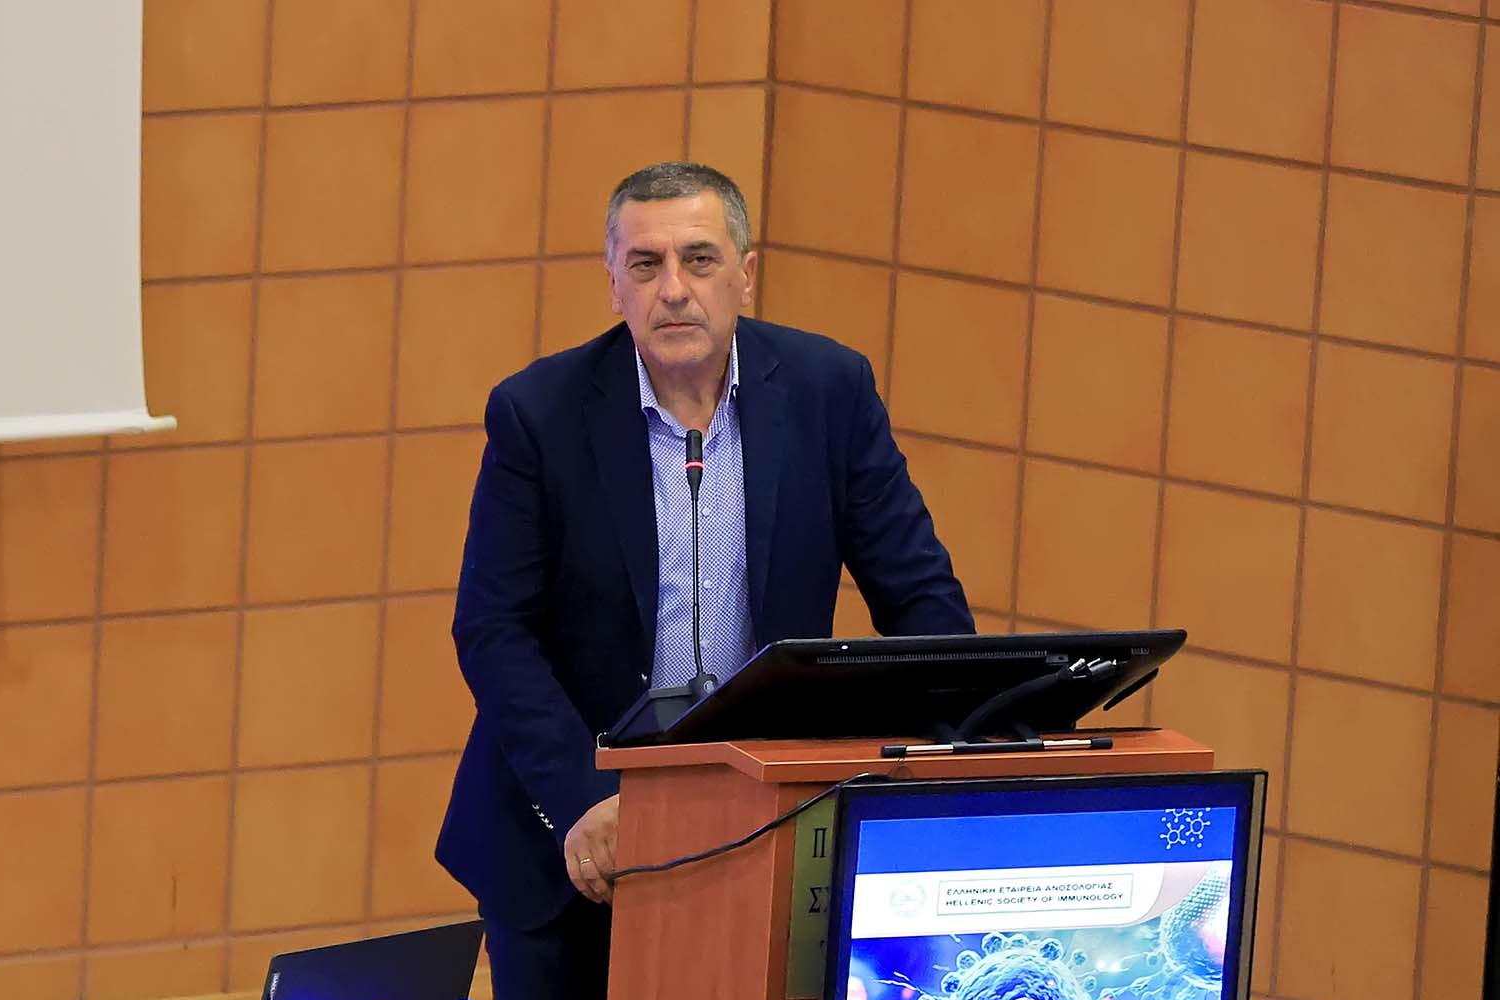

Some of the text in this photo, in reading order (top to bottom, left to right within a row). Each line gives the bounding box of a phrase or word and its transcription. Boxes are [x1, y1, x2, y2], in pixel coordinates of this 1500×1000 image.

[1045, 882, 1113, 892] ΑΝΟΣΟΛΟΓΙΑΣ
[945, 898, 993, 906] HELLENIC
[997, 896, 1038, 905] SOCIETY
[1057, 893, 1124, 902] IMMUNOLOGY
